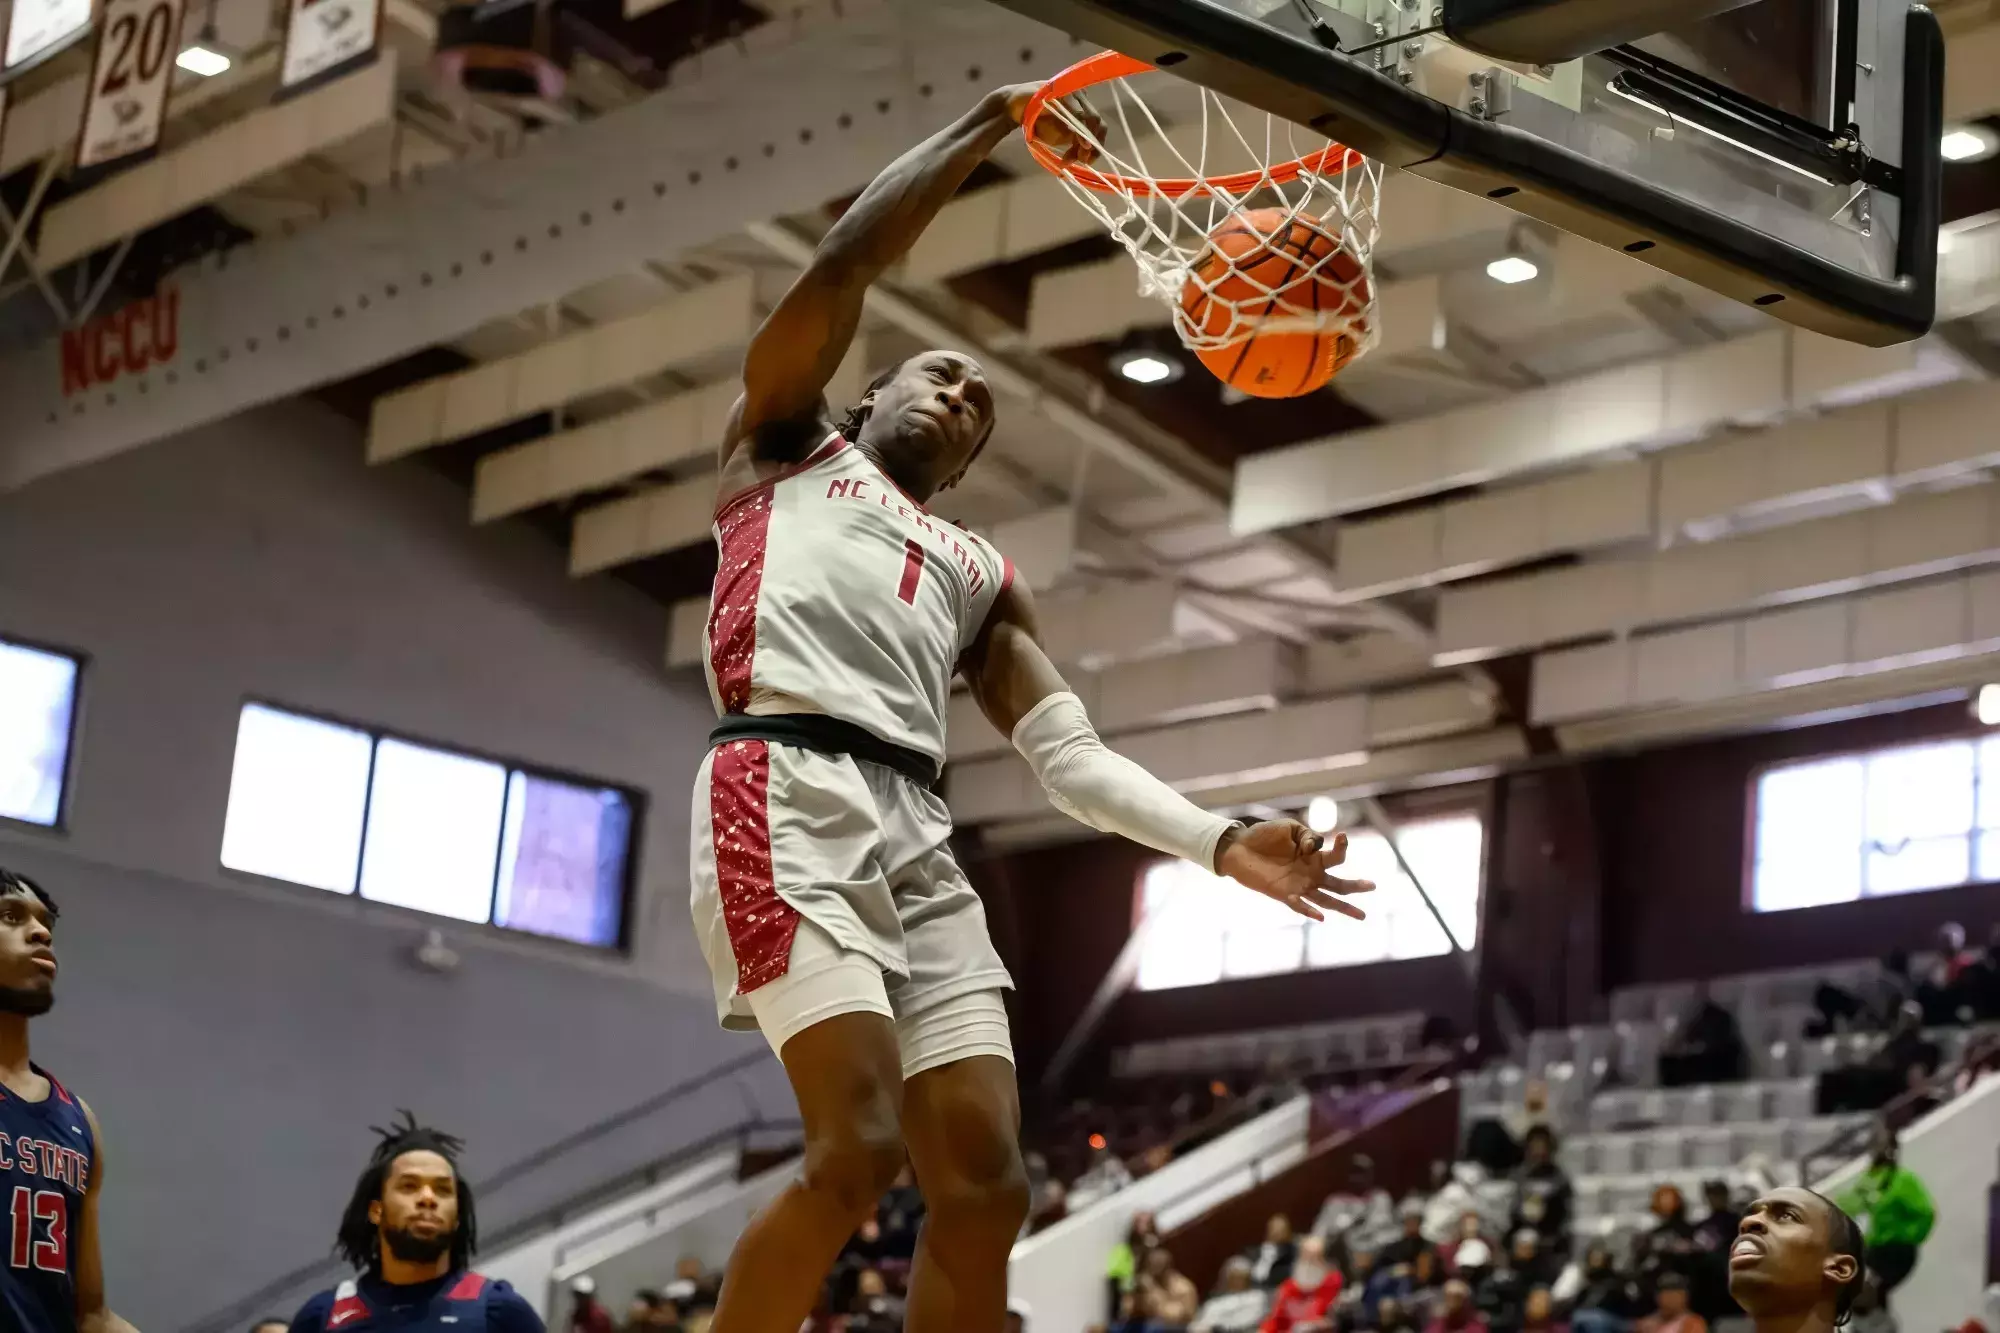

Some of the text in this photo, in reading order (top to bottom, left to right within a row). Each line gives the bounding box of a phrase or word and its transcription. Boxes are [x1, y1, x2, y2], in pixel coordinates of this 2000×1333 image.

[101, 3, 172, 95] 20
[61, 287, 180, 398] NCCU
[826, 478, 871, 499] NC
[897, 538, 925, 607] 1
[16, 1135, 89, 1195] STATE
[10, 1185, 67, 1274] 13
